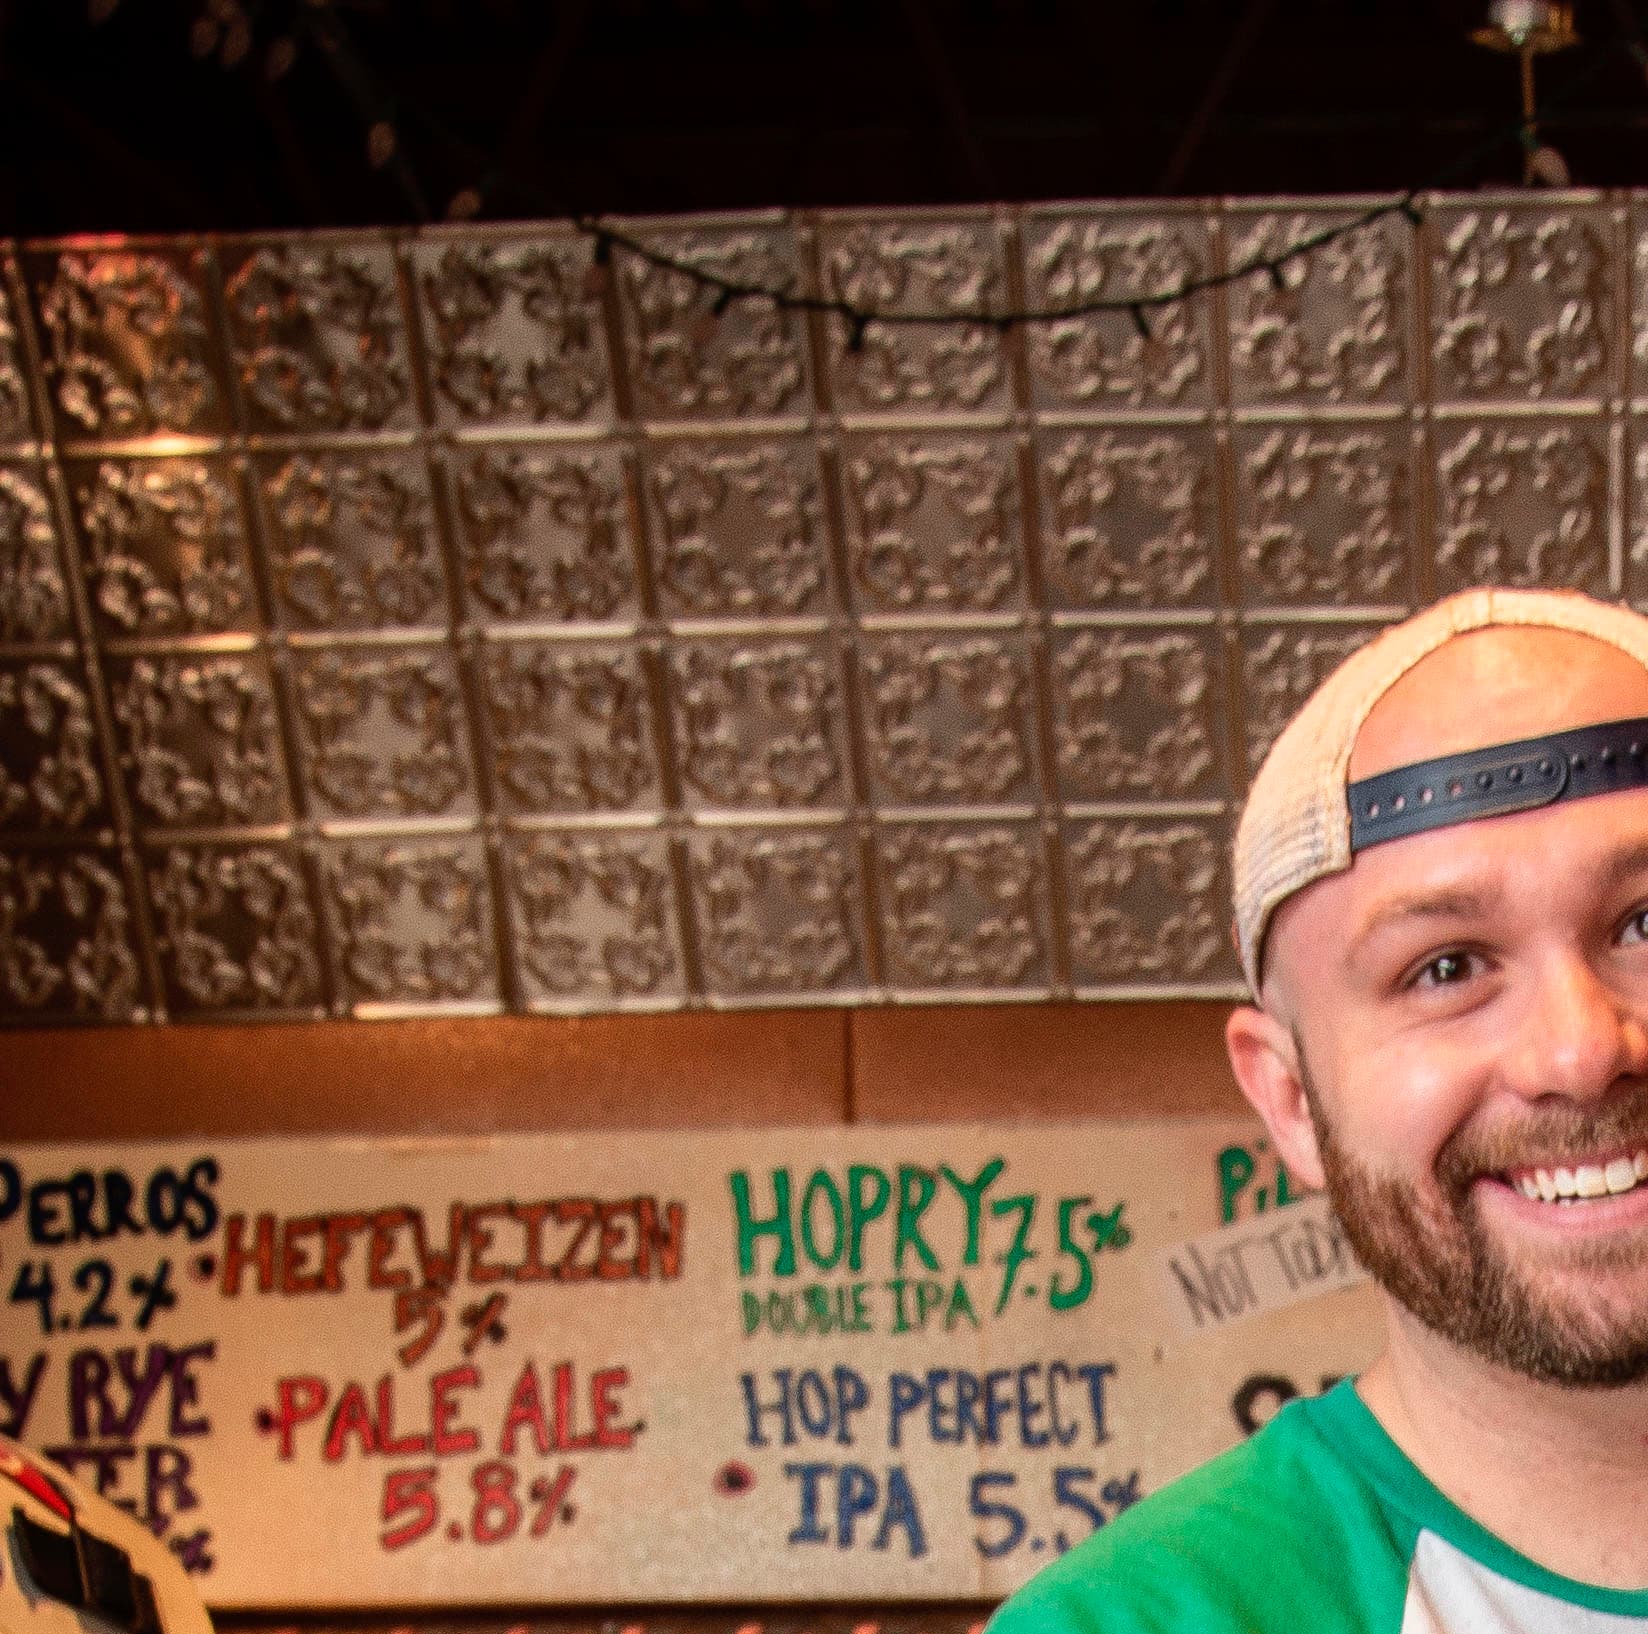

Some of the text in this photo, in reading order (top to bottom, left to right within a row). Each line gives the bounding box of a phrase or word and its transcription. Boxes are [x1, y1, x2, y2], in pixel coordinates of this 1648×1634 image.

[220, 1197, 684, 1296] HEFEWEIZEN
[728, 1157, 1132, 1317] HOPRY 7.5%
[393, 1288, 507, 1366] 5%
[740, 1277, 981, 1336] DOUBLE IPA
[70, 1340, 216, 1440] RYE
[276, 1365, 482, 1462] PALE
[740, 1362, 1118, 1449] HOP PERFECT
[380, 1460, 578, 1551] 5.8%
[784, 1462, 930, 1559] IPA
